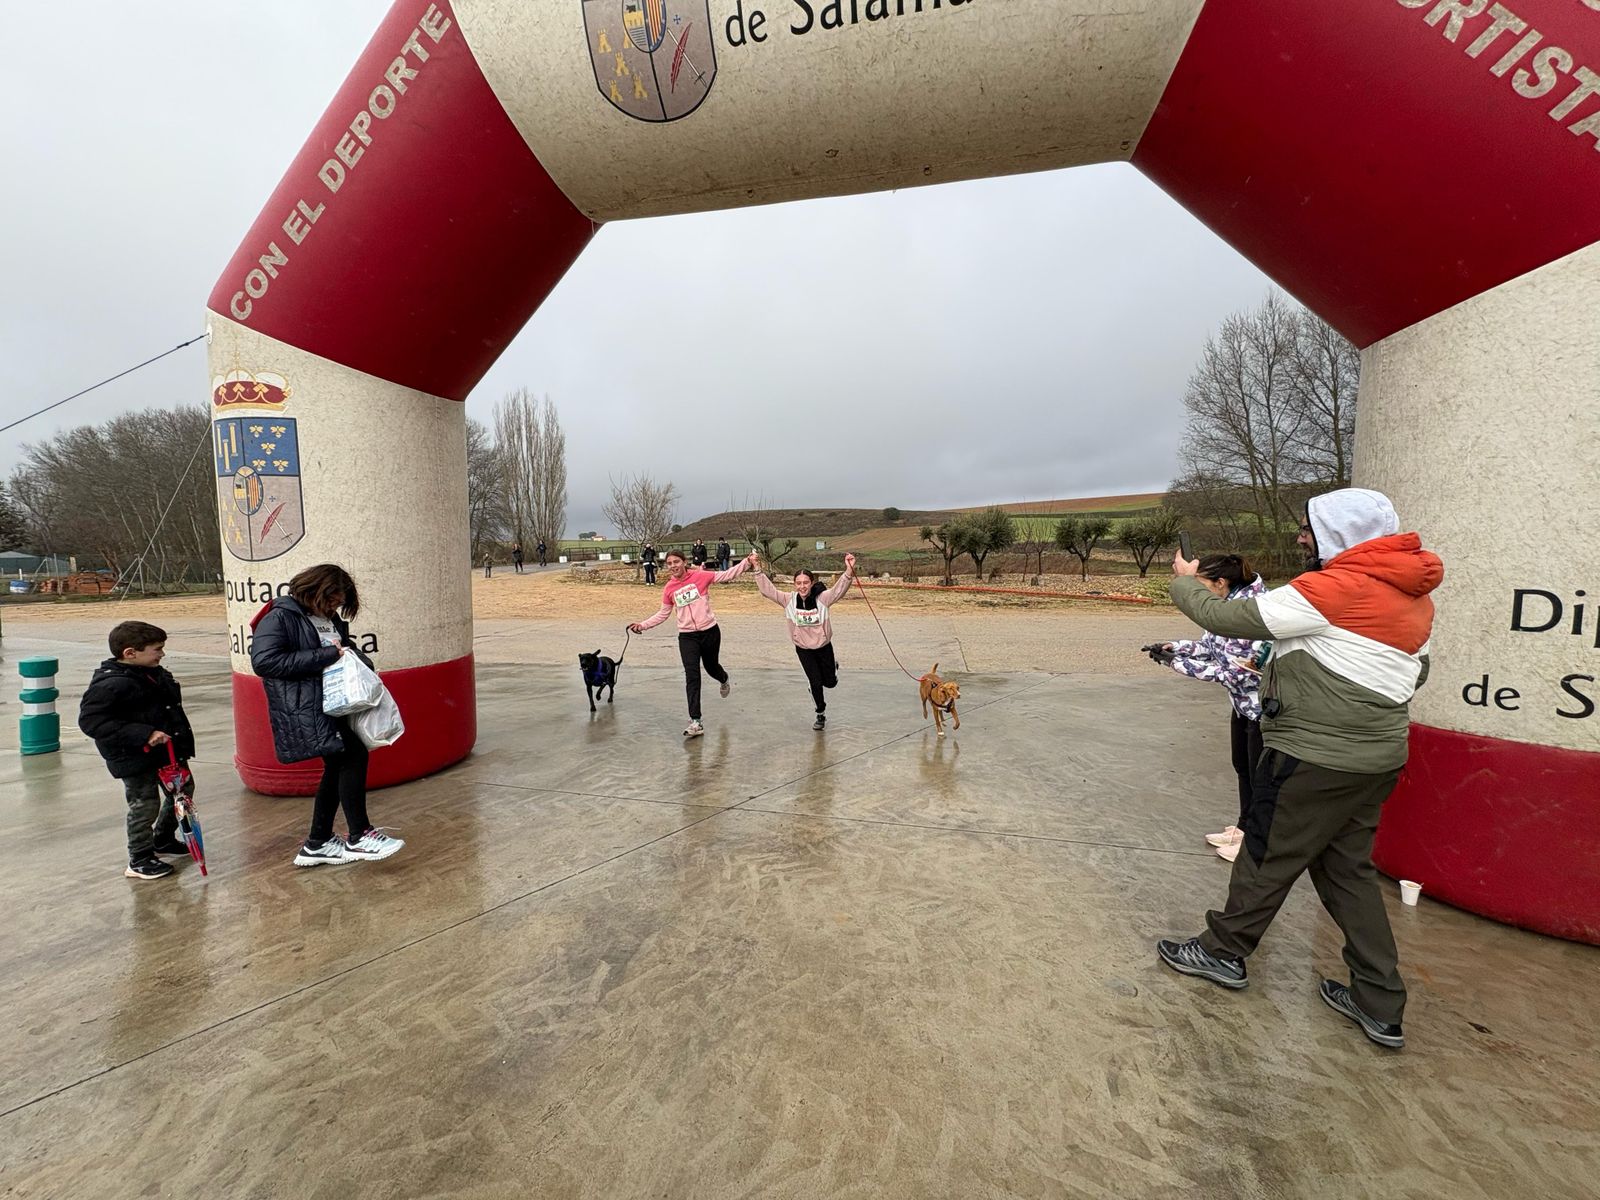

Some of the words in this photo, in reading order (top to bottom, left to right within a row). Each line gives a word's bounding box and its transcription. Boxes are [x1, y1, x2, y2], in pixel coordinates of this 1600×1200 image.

[725, 0, 768, 47] de
[230, 241, 289, 320] CON
[282, 199, 326, 246] EL
[317, 3, 452, 193] DEPORTE
[1461, 673, 1521, 711] de
